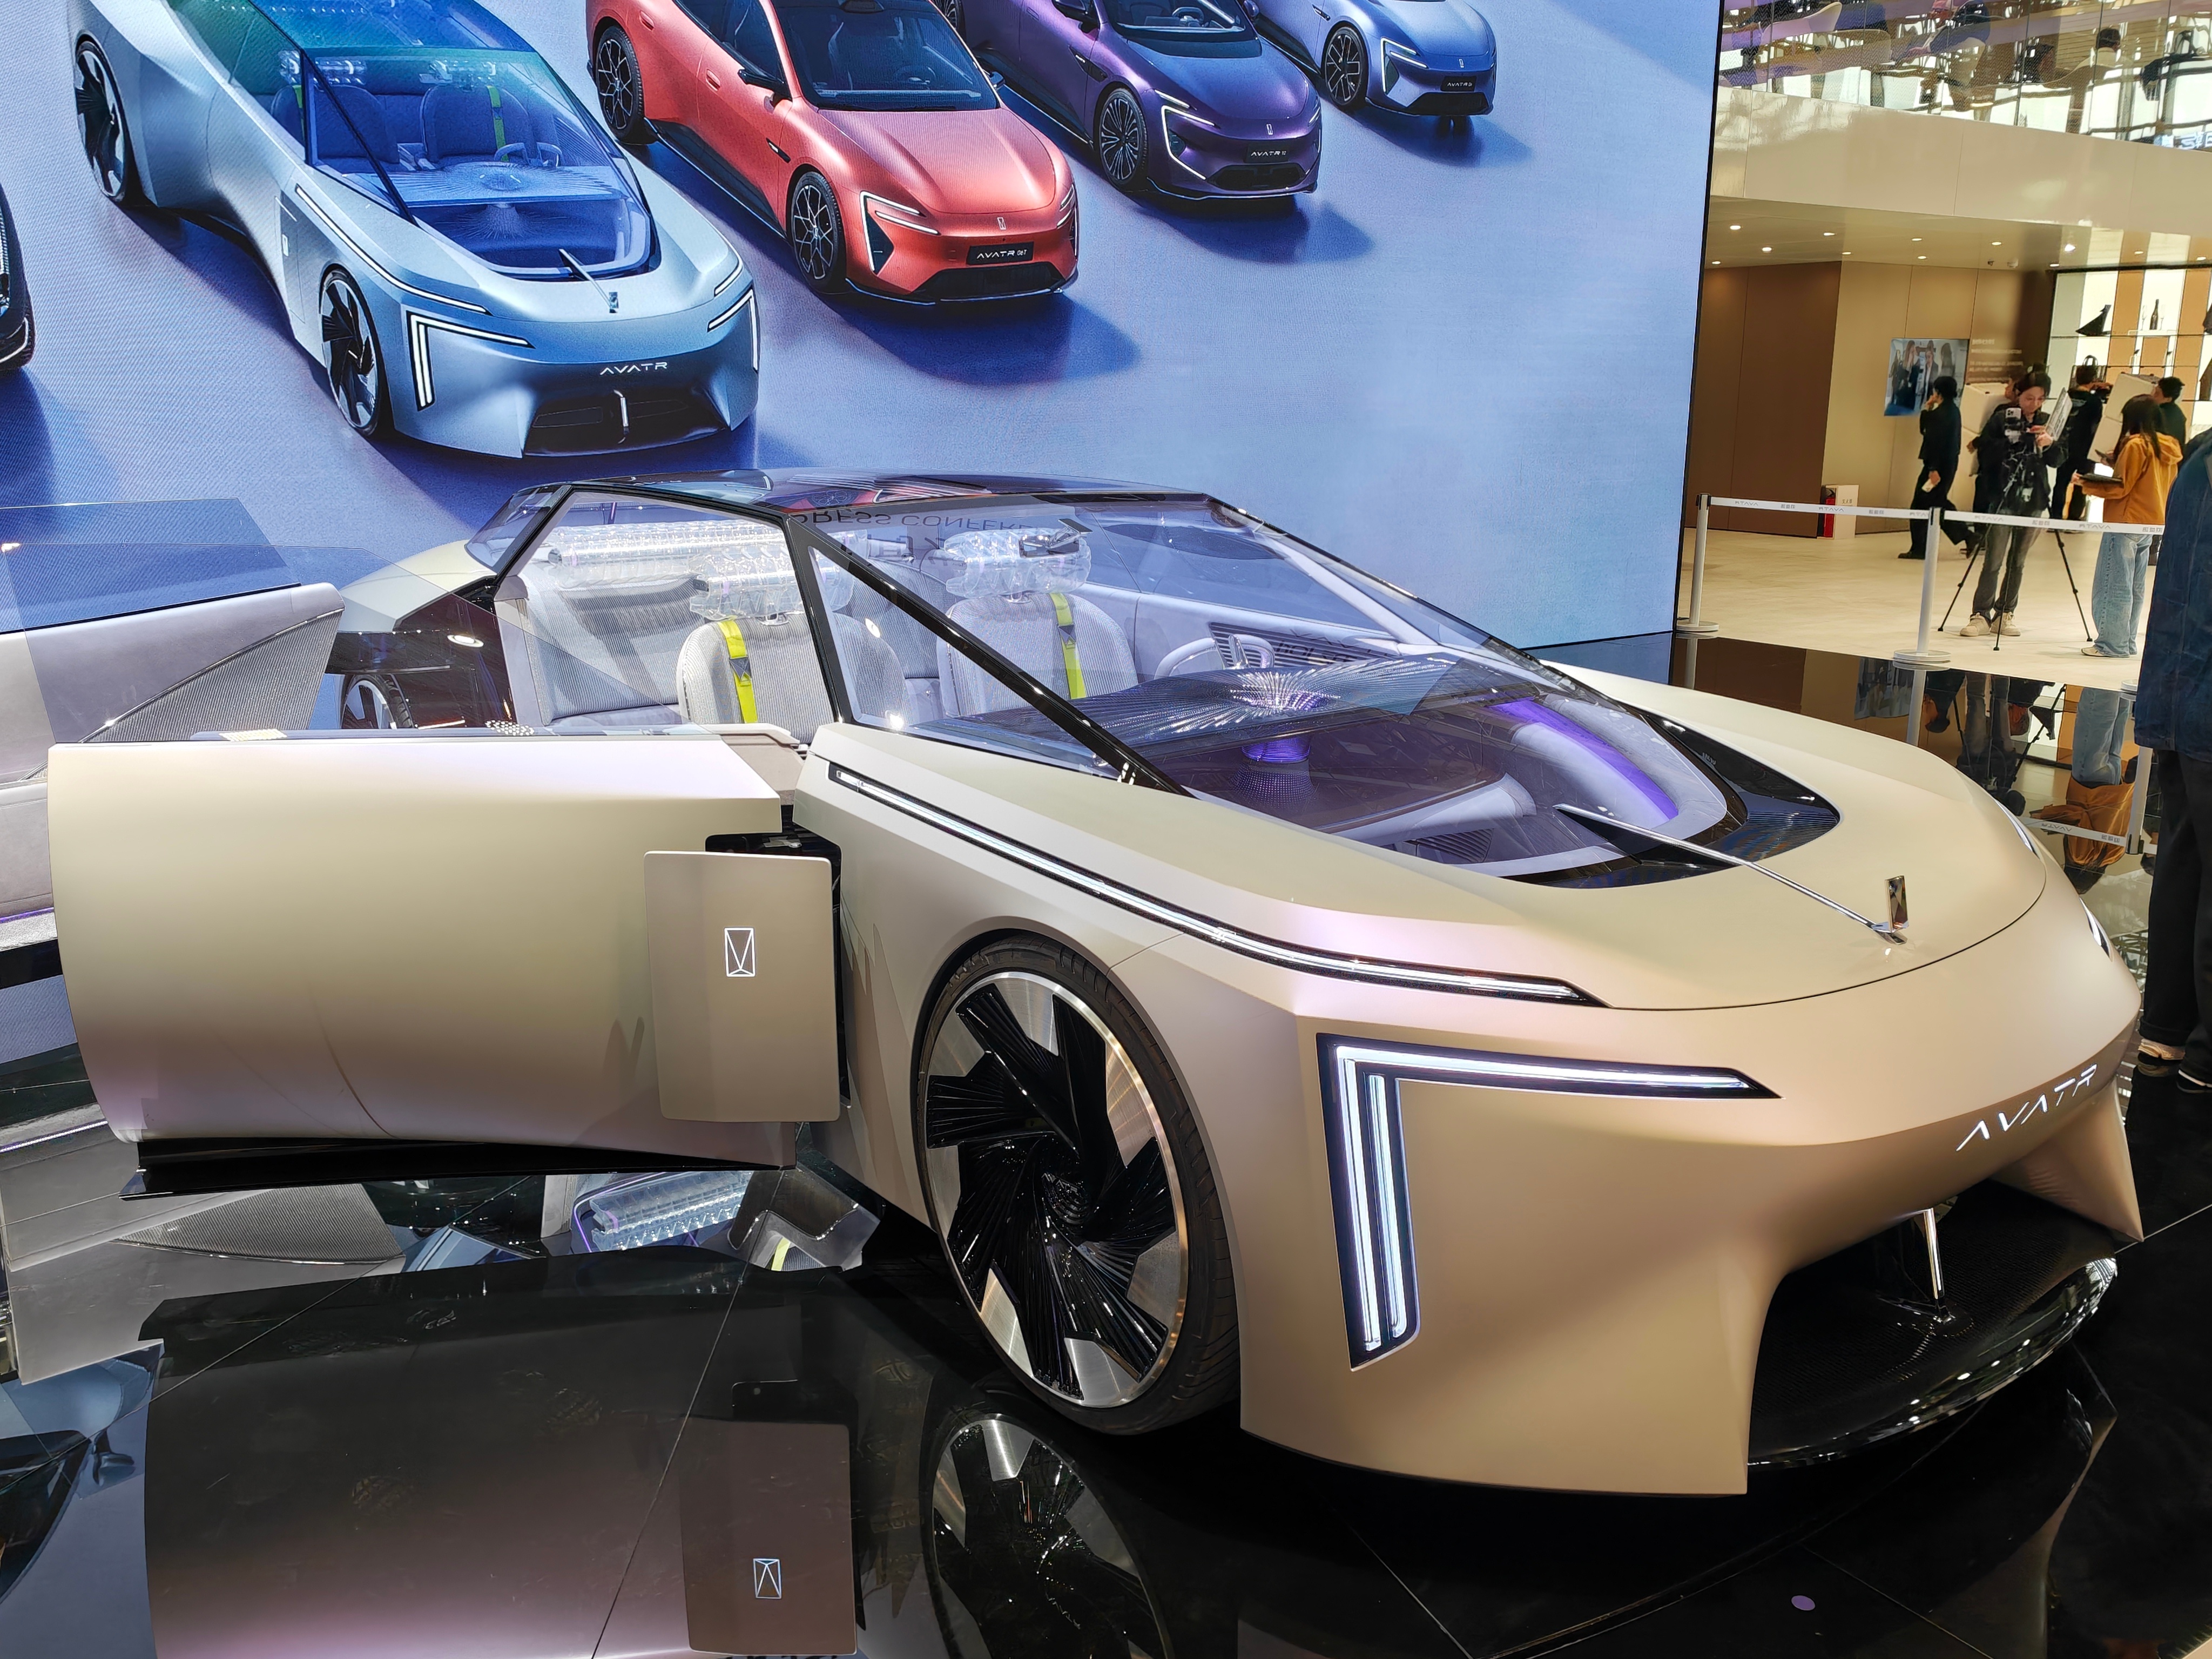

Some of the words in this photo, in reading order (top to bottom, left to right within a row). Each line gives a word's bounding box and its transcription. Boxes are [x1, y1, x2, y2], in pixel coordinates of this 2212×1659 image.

[977, 251, 1015, 259] AVATR
[600, 362, 667, 375] AVATR
[1955, 1063, 2098, 1152] AVATR
